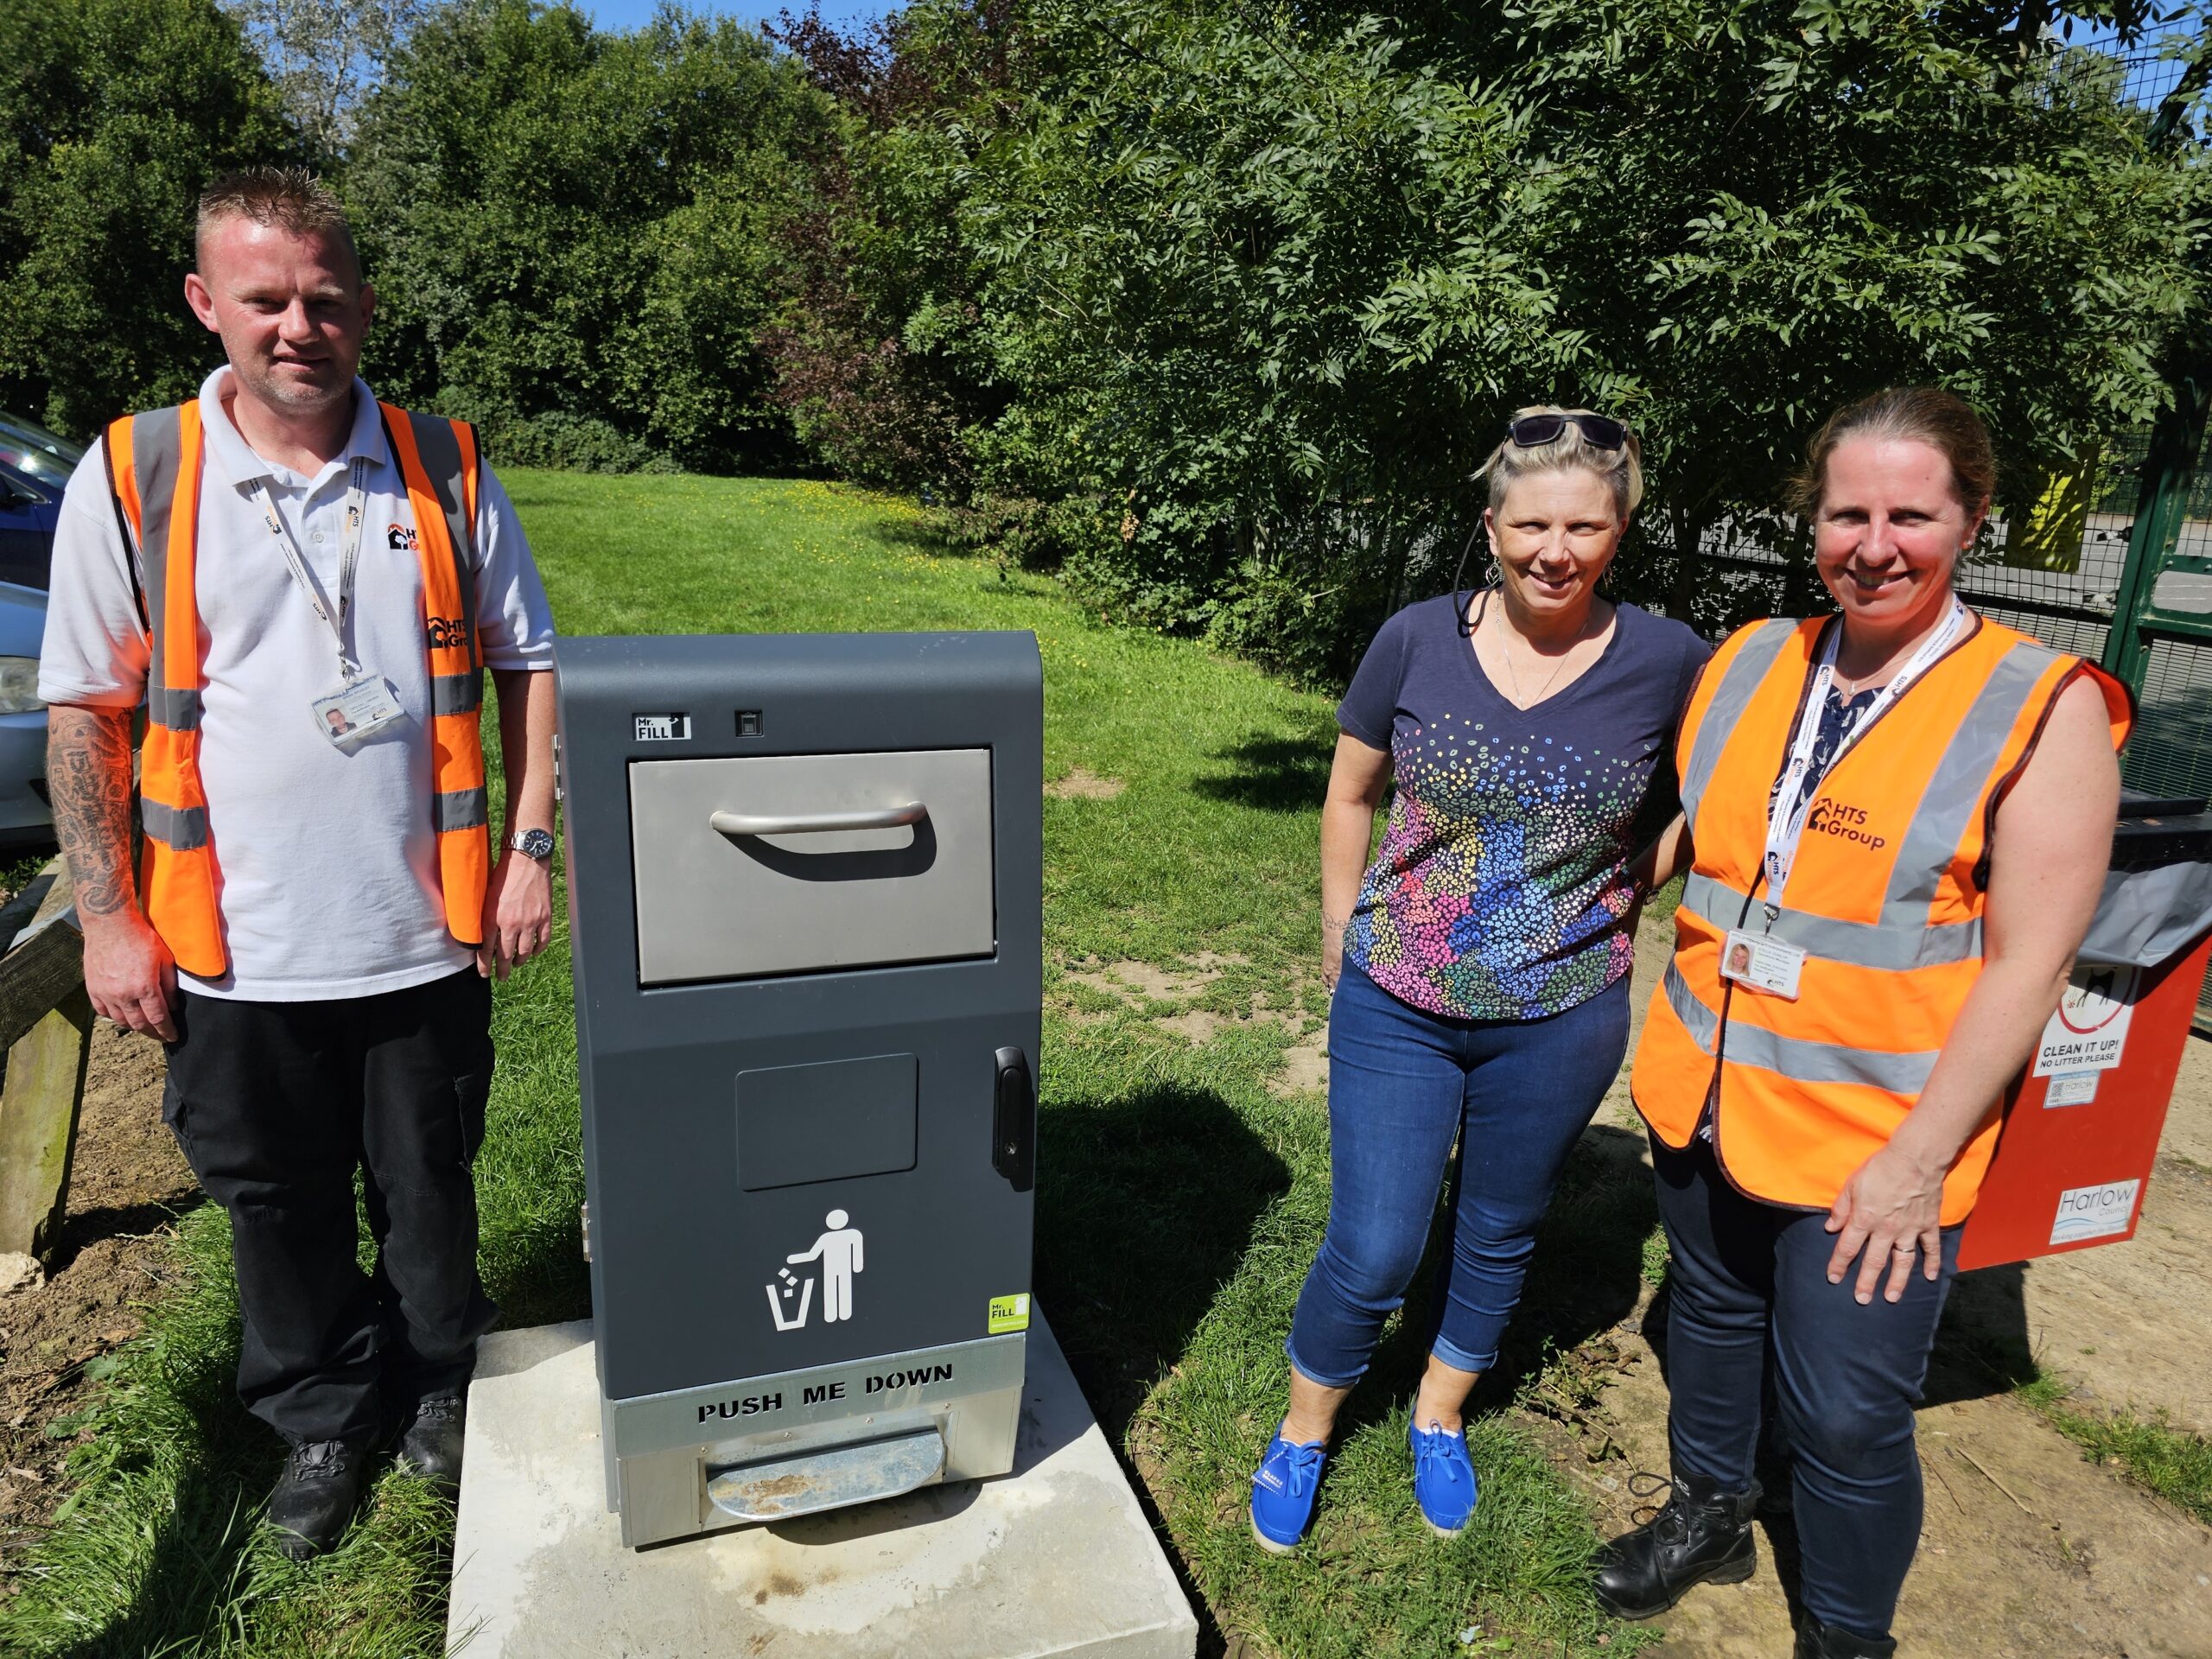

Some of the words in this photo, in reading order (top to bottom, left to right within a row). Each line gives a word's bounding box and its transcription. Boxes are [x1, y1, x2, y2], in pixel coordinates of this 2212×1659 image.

[1821, 674, 1830, 686] HTS
[1895, 675, 1908, 688] HTS
[639, 727, 669, 739] FILL
[1833, 804, 1868, 824] HTS
[1827, 819, 1885, 851] Group
[2044, 1043, 2082, 1058] CLEAN
[2085, 1041, 2097, 1053] IT
[2100, 1039, 2119, 1051] UP!
[2055, 1056, 2083, 1066] LITTER
[2085, 1053, 2115, 1063] PLEASE
[2064, 1081, 2093, 1090] Harlow
[2060, 1186, 2135, 1213] Harlow
[992, 1308, 1014, 1319] FILL
[698, 1393, 782, 1423] PUSH
[804, 1382, 845, 1405] ME
[866, 1363, 952, 1394] DOWN
